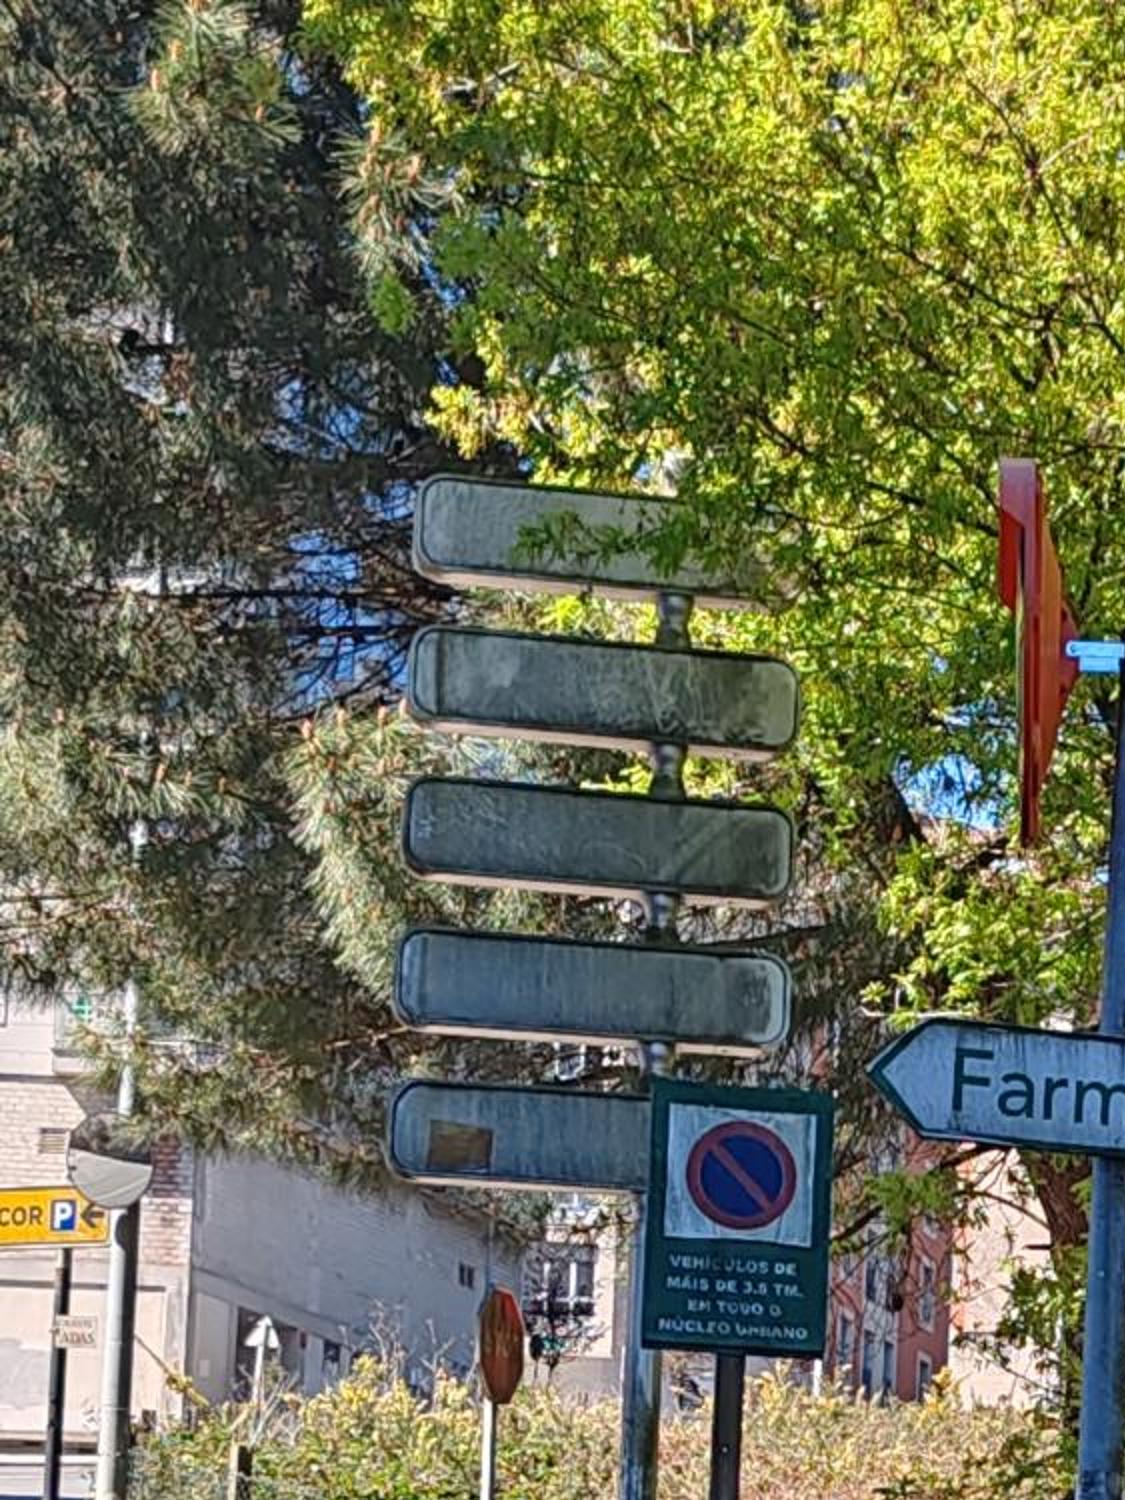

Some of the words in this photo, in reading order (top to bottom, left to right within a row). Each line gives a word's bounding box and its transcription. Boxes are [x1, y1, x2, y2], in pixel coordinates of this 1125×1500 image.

[774, 1262, 797, 1276] DE
[666, 1275, 710, 1291] MÁIS
[715, 1280, 738, 1293] DE
[716, 1300, 764, 1315] TODO
[658, 1315, 731, 1334] NÚCLEO
